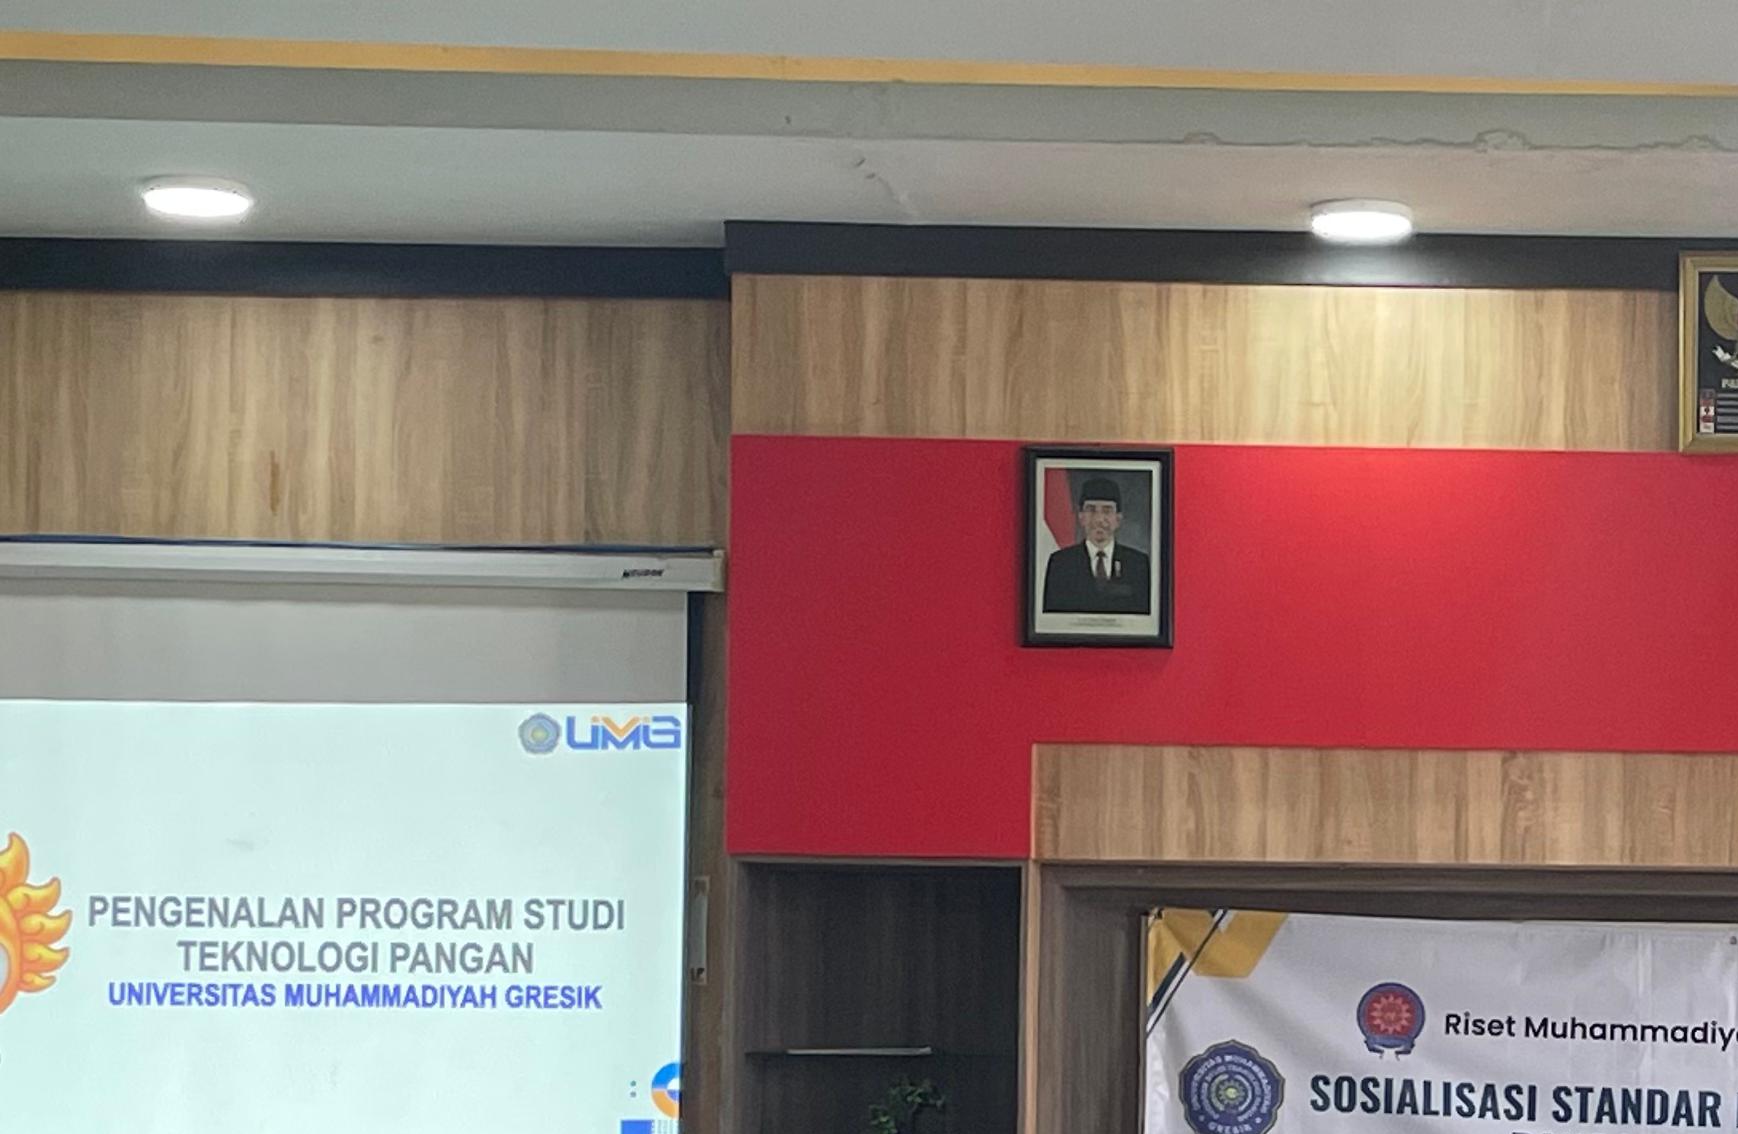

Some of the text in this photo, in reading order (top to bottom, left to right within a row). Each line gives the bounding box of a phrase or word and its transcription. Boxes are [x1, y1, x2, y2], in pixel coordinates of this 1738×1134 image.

[565, 715, 682, 750] UMG
[88, 895, 625, 931] PENGENALAN PROGRAM STUDI
[175, 939, 534, 975] TEKNOLOGI PANGAN
[108, 981, 603, 1010] UNIVERSITAS MUHAMMADIYAH GRESIK
[1444, 1011, 1516, 1038] Riset
[1309, 1074, 1538, 1122] SOSIALISASI
[1551, 1085, 1722, 1128] STANDAR
